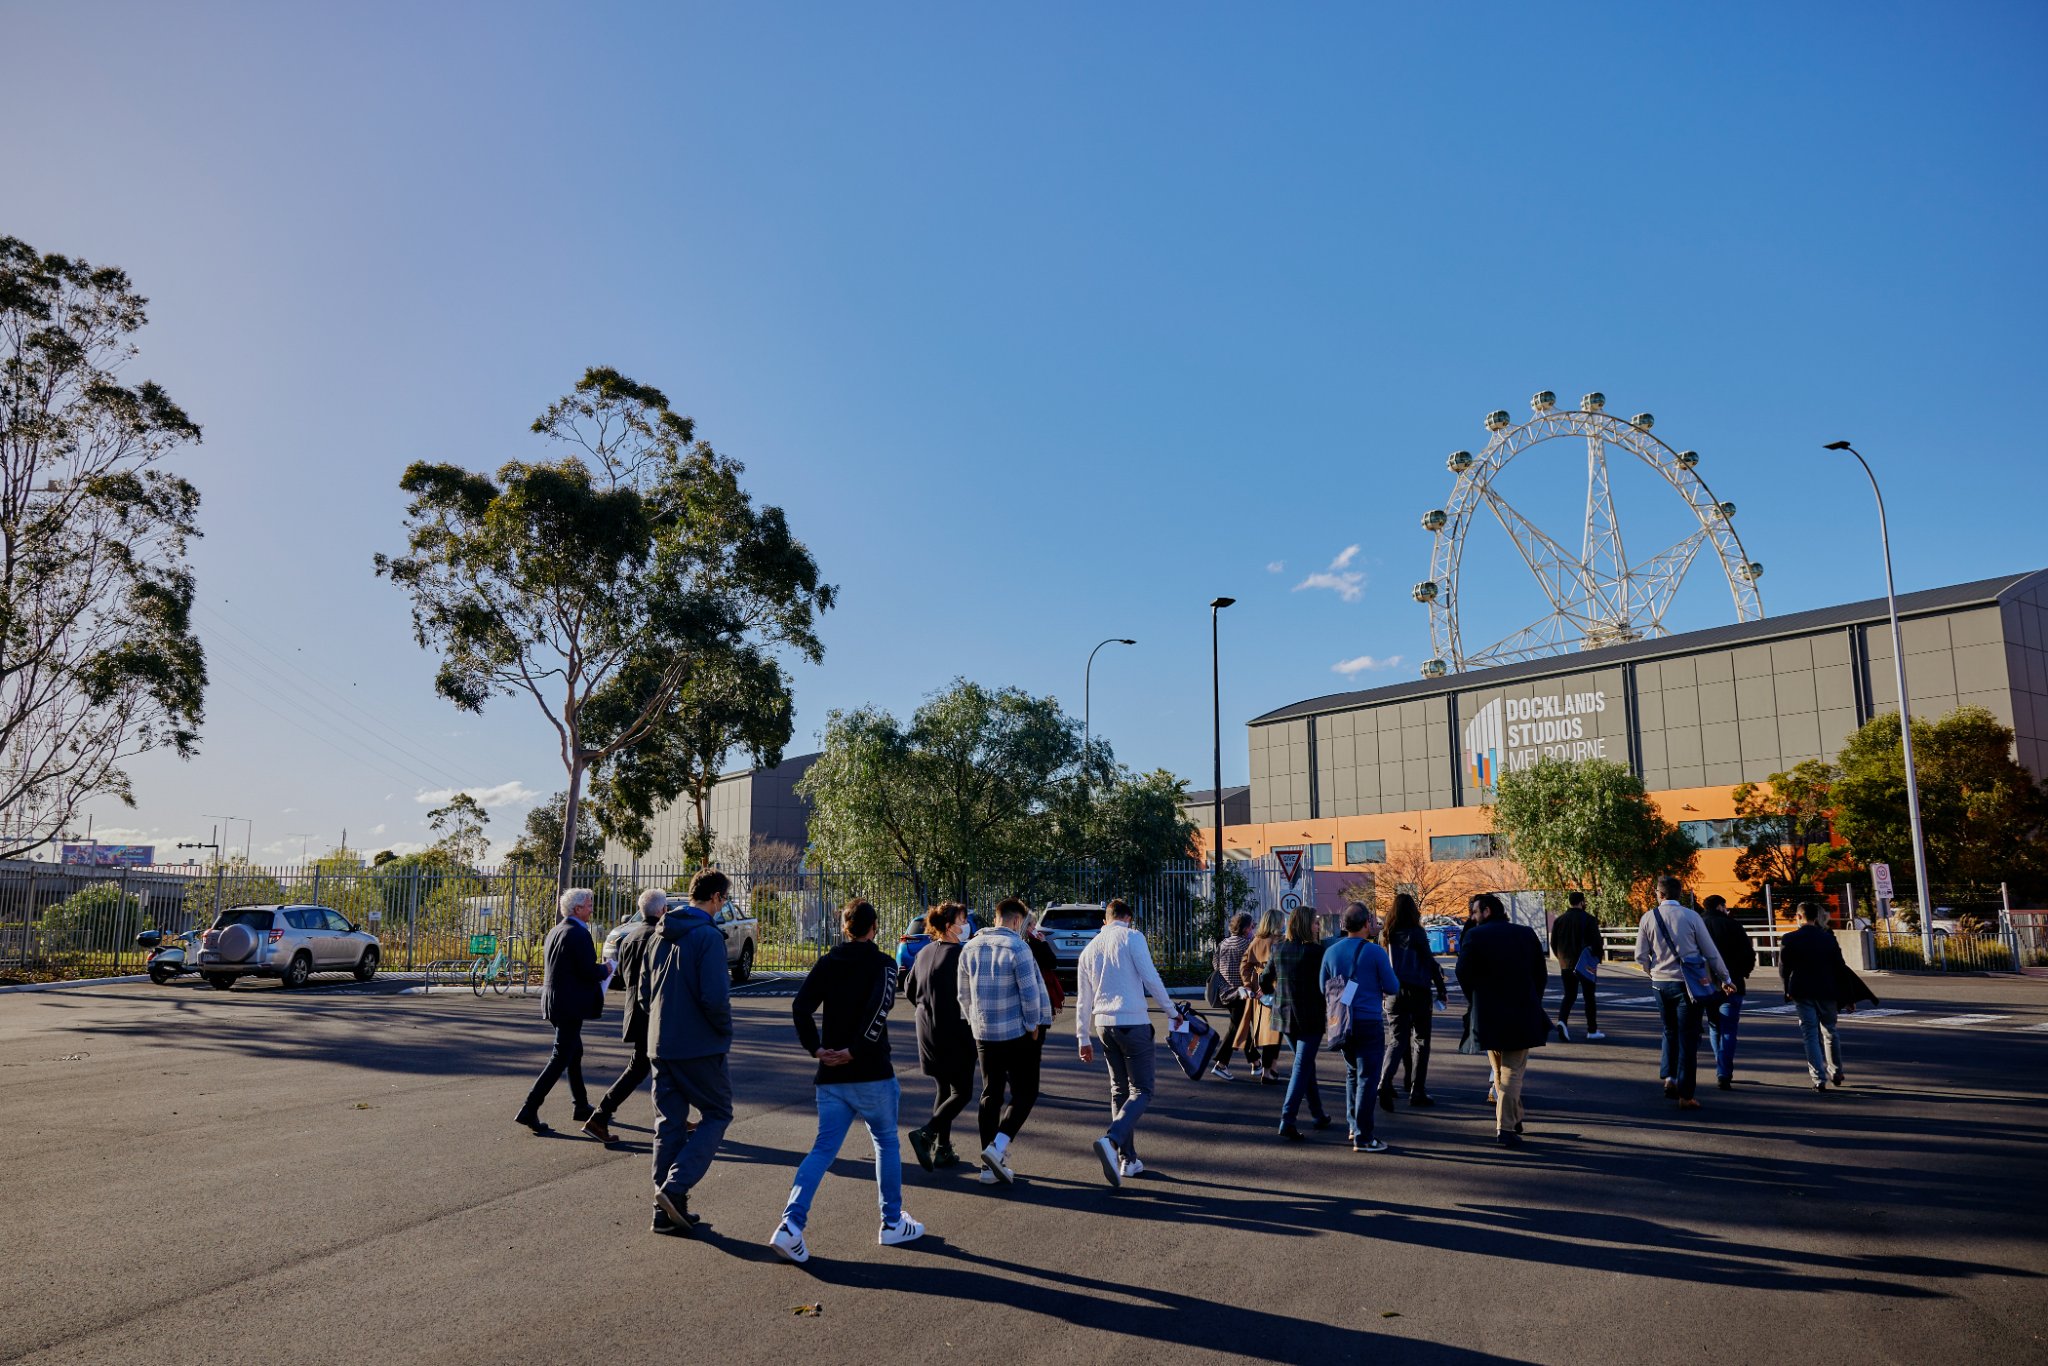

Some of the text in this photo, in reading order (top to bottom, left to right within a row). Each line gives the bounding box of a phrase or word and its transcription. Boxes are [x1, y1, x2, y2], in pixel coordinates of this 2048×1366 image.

[1506, 691, 1605, 722] DOCKLANDS
[1508, 717, 1583, 748] STUDIOS
[1285, 898, 1297, 910] 10
[869, 1009, 888, 1037] NEW
